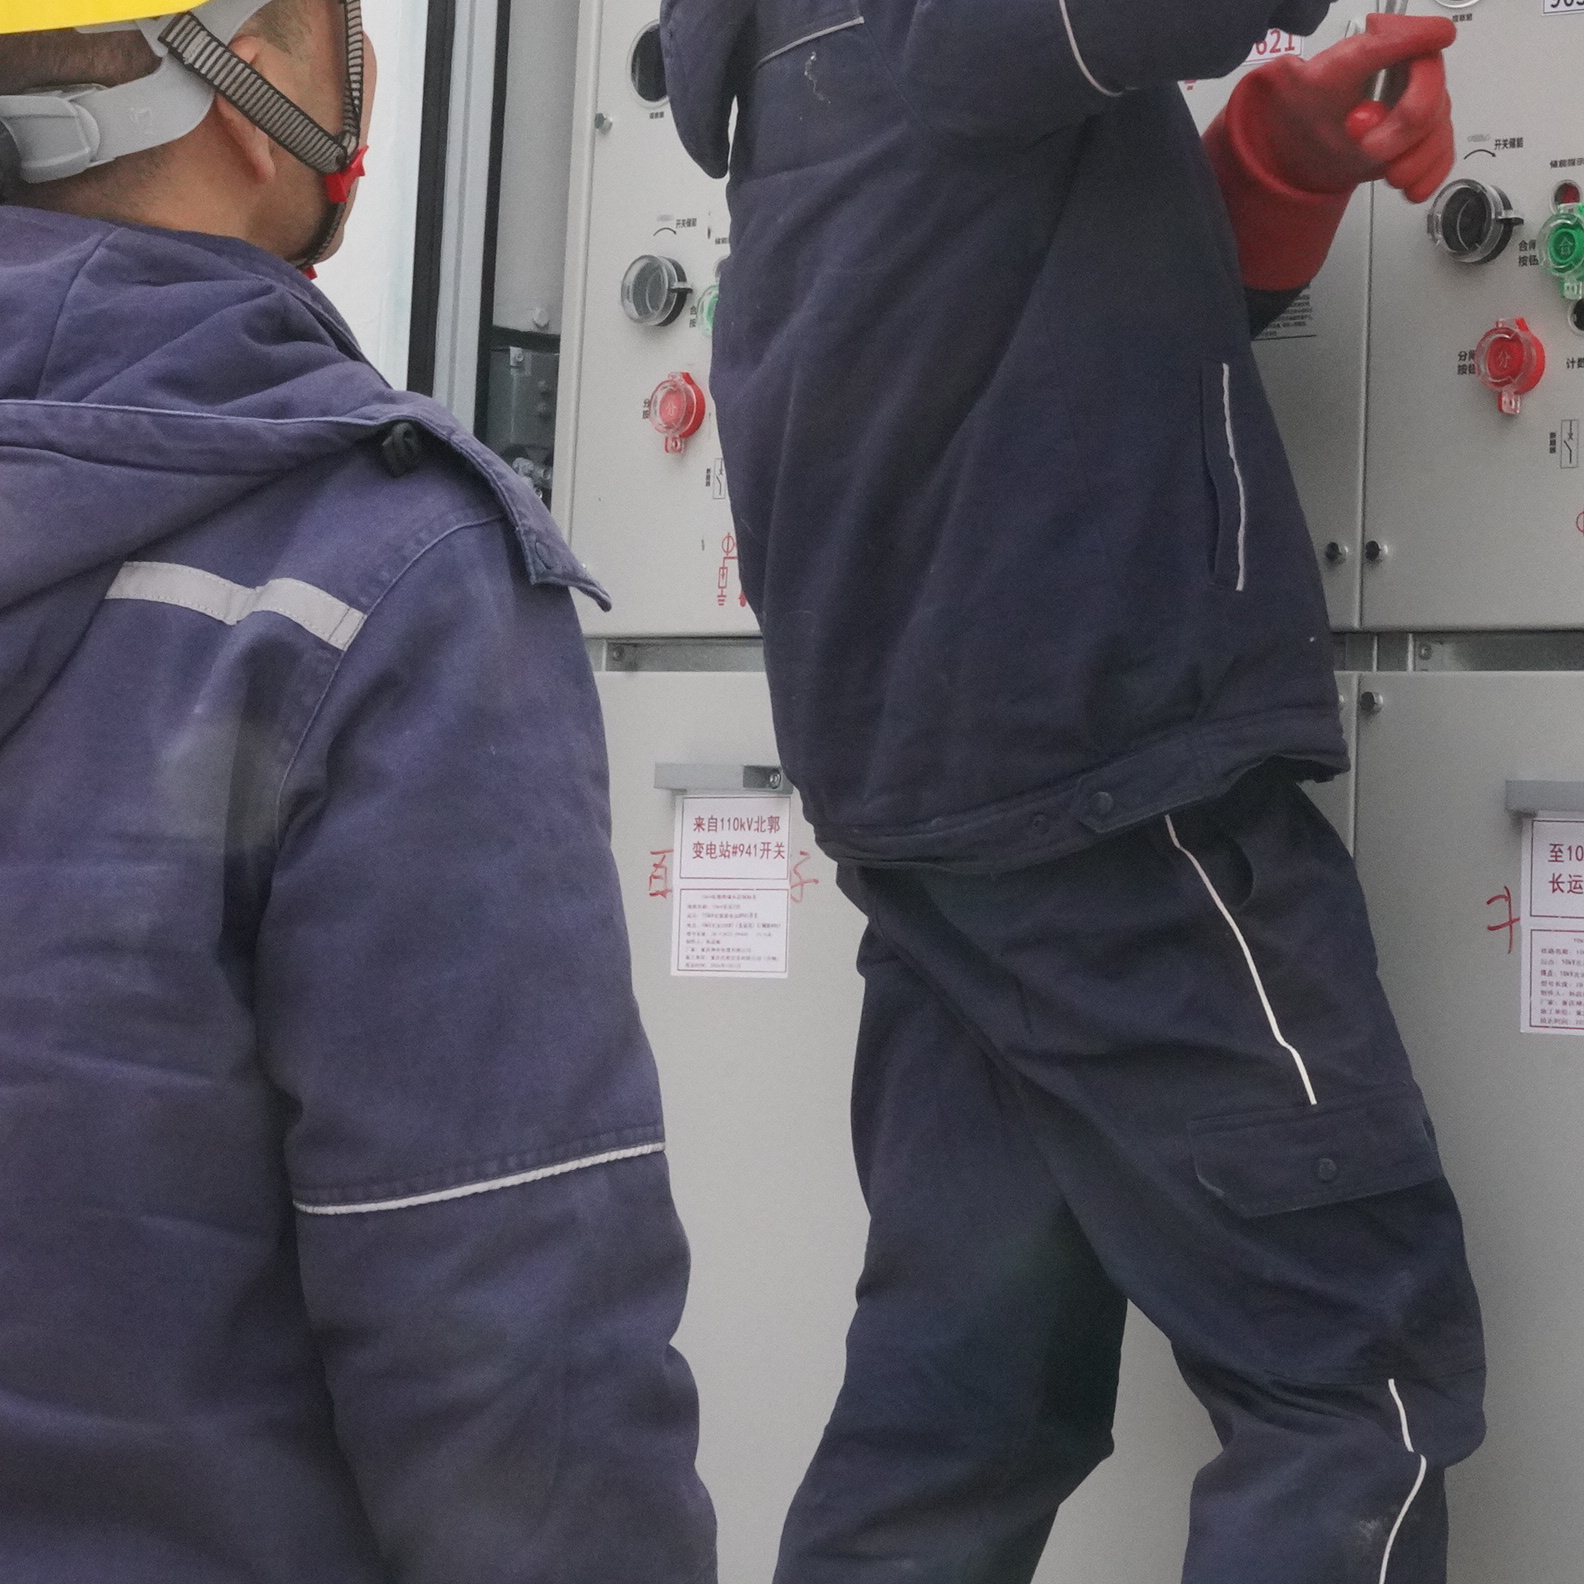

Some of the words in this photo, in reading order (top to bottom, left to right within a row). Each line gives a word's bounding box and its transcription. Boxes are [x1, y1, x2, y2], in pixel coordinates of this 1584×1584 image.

[1256, 29, 1295, 55] 621
[693, 815, 781, 834] 来自110kV北郭
[692, 841, 786, 860] 变电站#941开关
